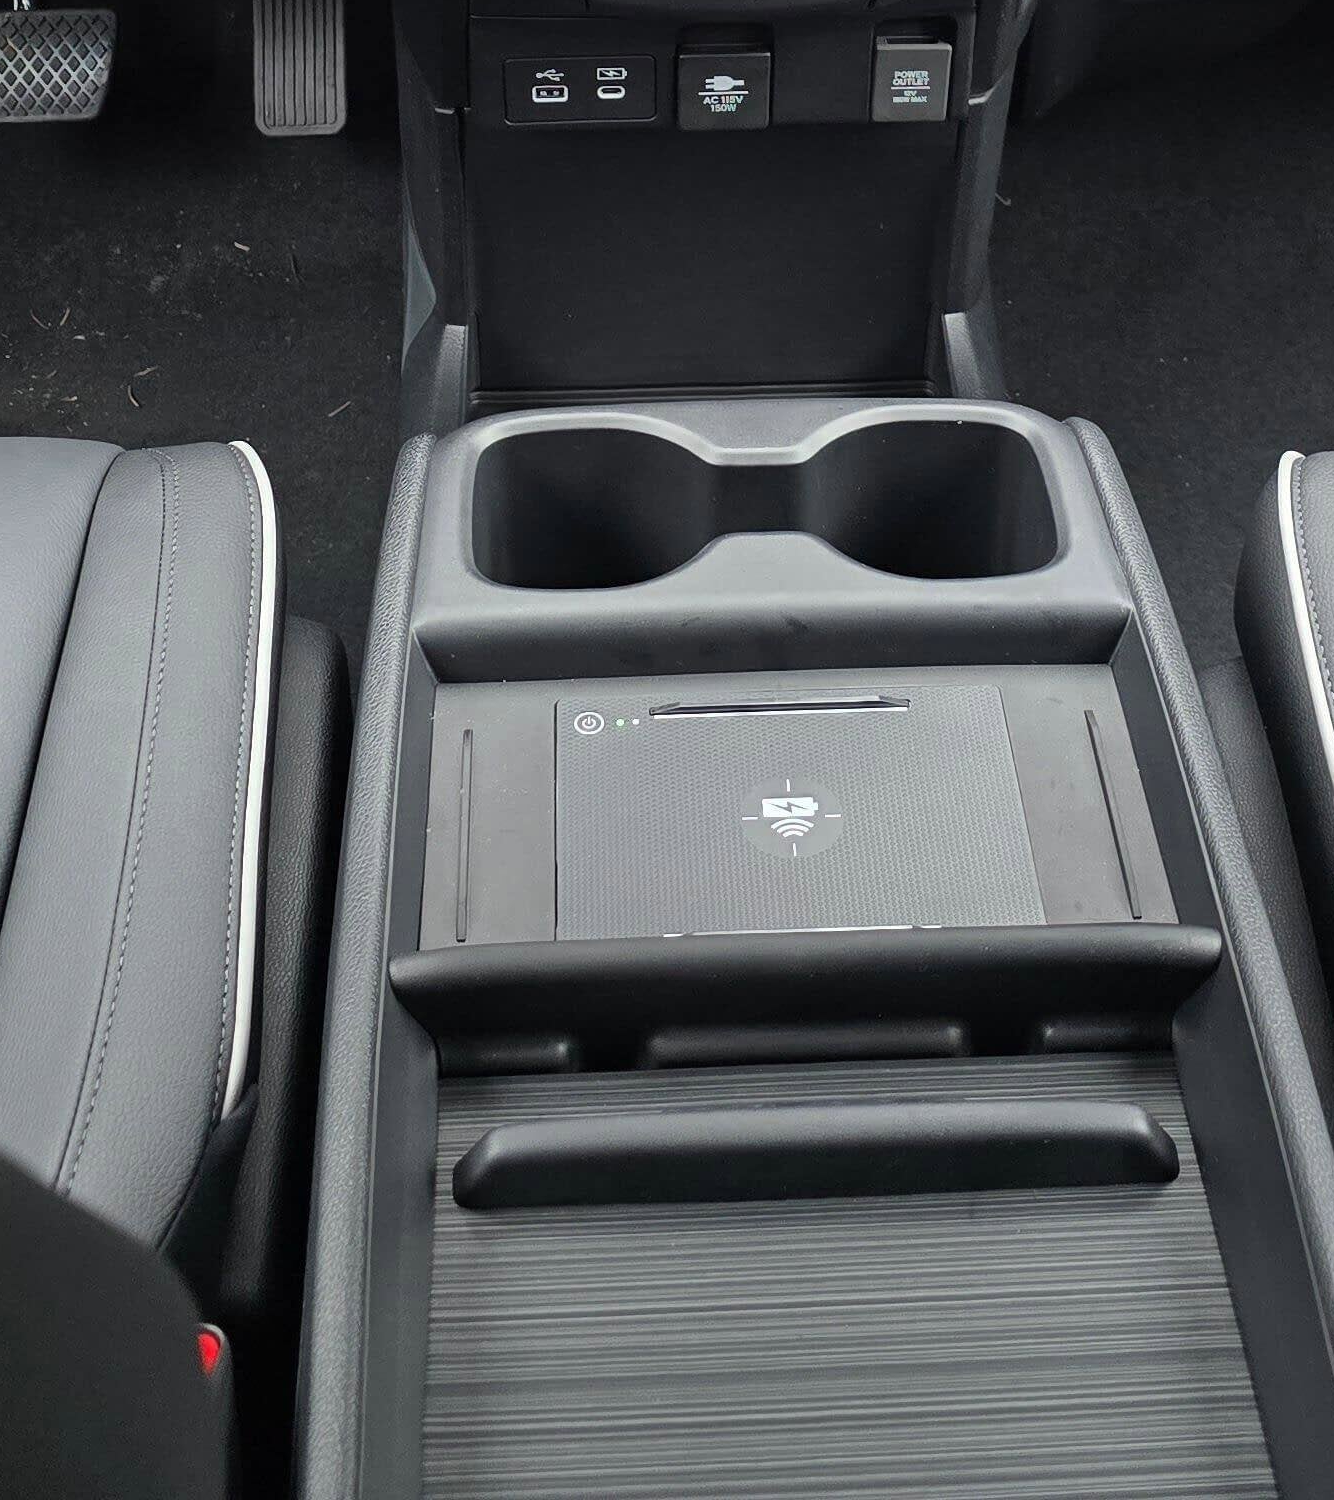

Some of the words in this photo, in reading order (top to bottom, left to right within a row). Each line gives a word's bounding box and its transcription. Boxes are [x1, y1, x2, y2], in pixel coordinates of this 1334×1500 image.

[894, 70, 929, 79] POWER
[892, 78, 930, 86] OUTLET
[703, 96, 720, 105] AC
